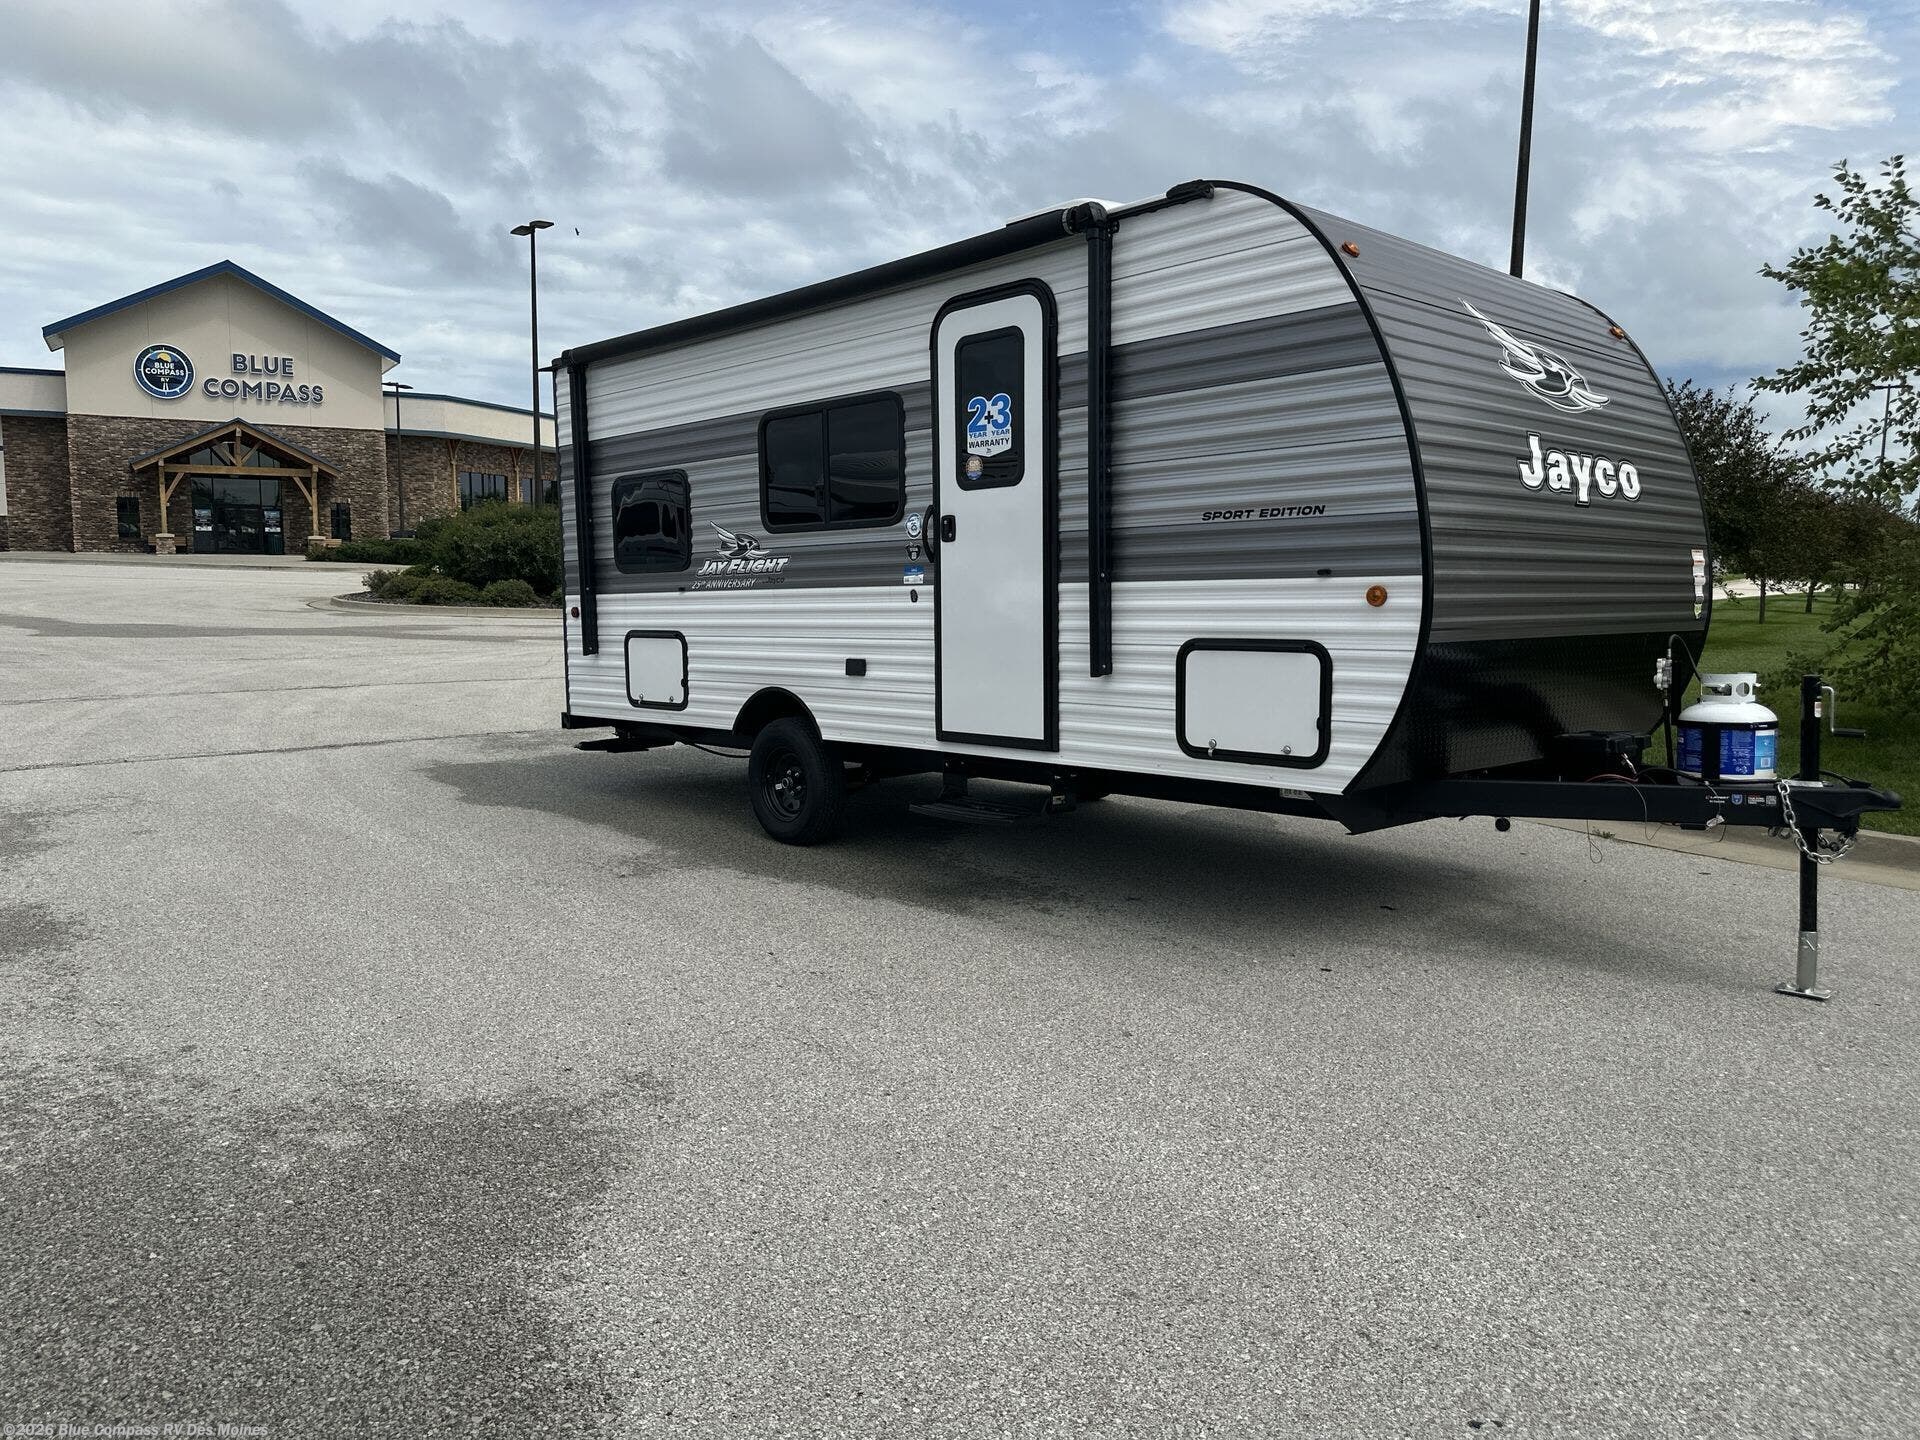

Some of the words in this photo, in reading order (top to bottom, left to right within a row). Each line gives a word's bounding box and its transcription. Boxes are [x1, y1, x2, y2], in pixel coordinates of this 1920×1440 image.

[145, 368, 185, 376] COMPASS
[232, 353, 294, 377] BLUE
[203, 377, 324, 403] COMPASS
[968, 438, 1010, 449] WARRANTY
[1518, 432, 1642, 506] Jayco
[1201, 509, 1254, 521] SPORT
[1258, 505, 1327, 519] EDITION
[697, 560, 728, 576] JAY
[727, 557, 789, 575] FLIGHT
[706, 578, 756, 589] ANNIVERSARY
